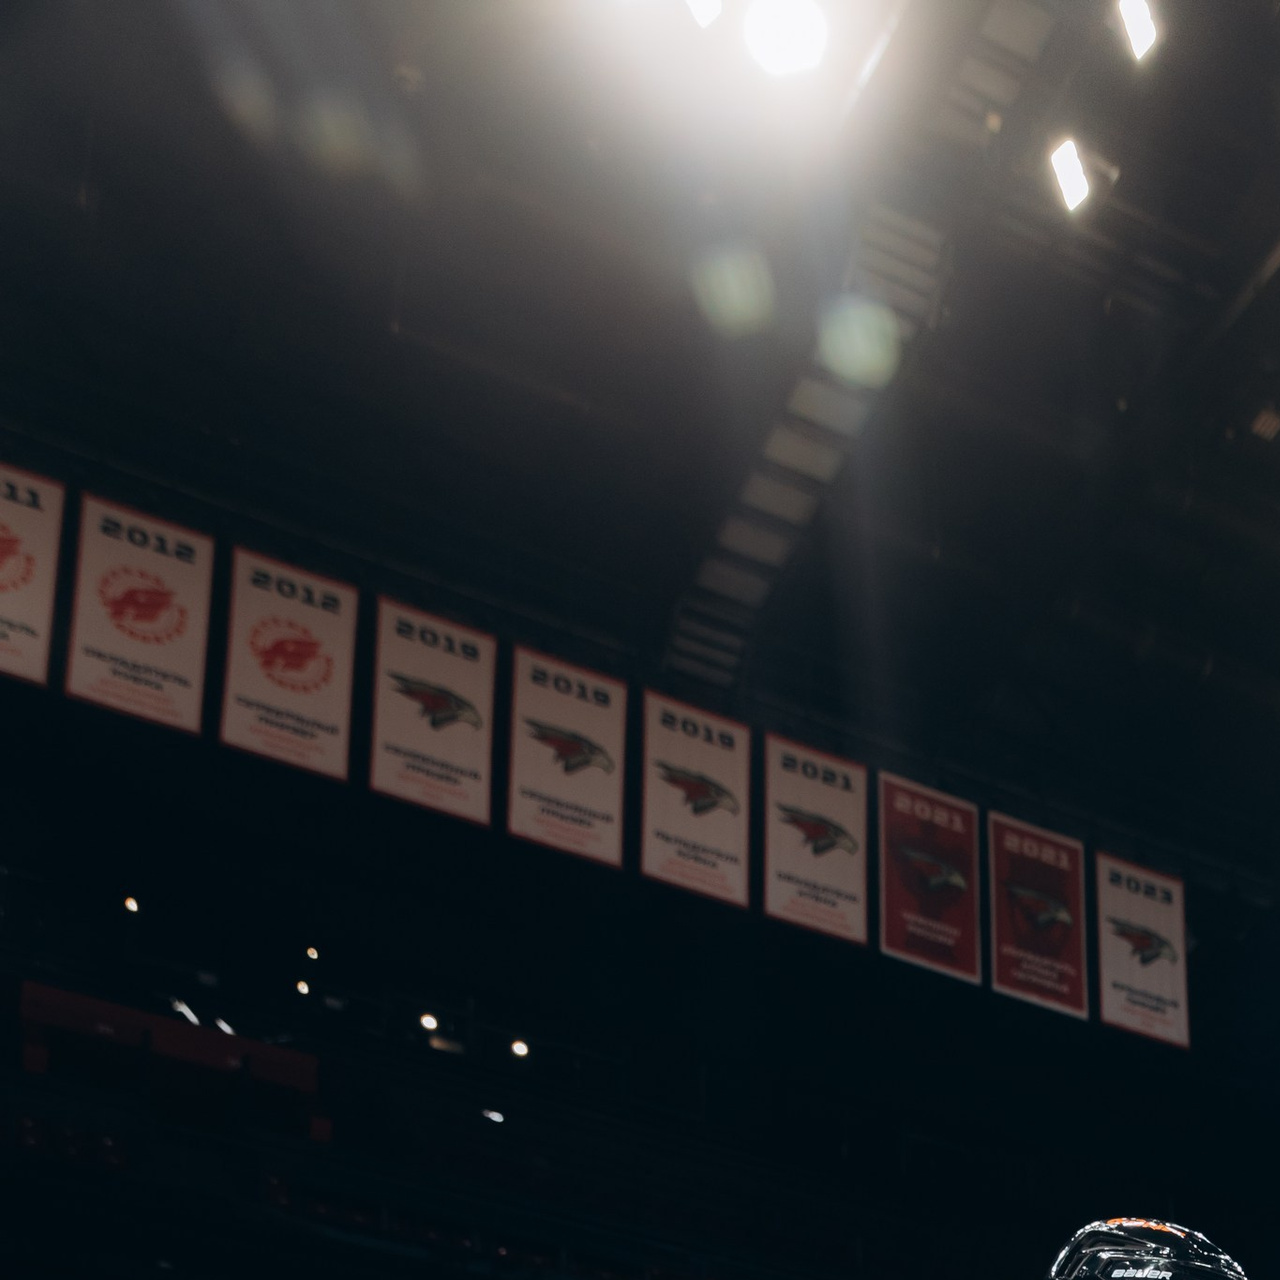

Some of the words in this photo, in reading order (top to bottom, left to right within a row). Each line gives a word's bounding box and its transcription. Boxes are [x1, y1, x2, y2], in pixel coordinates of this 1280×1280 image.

[100, 517, 196, 565] 2012
[250, 569, 342, 615] 2012
[396, 618, 480, 662] 2019
[531, 664, 611, 709] 2019
[661, 710, 737, 751] 2019
[780, 753, 856, 793] 2021
[893, 790, 967, 834] 2021
[1003, 832, 1073, 871] 2021
[1109, 868, 1174, 905] 2023
[1111, 1269, 1173, 1280] BAUER
